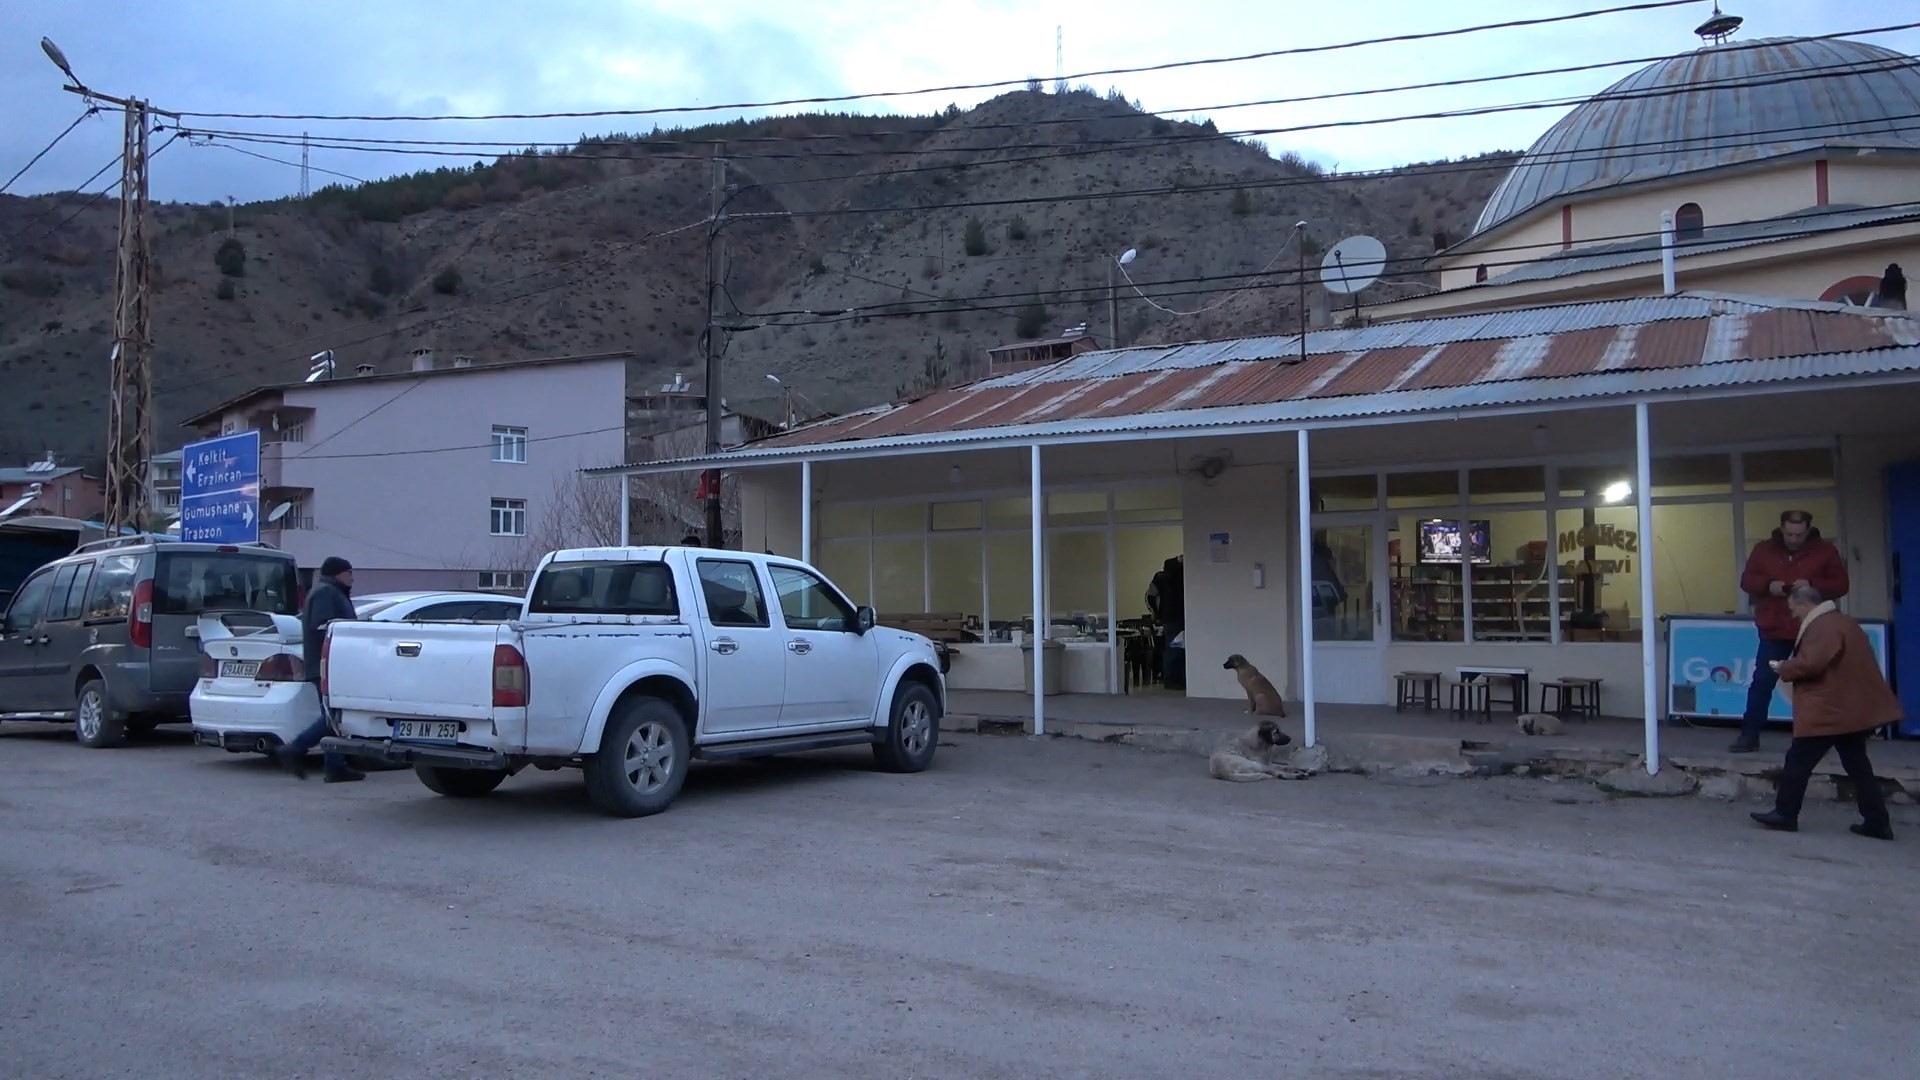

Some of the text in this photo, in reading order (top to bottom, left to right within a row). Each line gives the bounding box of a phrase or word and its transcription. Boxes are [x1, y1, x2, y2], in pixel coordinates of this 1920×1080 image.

[198, 448, 227, 466] Kelkit
[197, 470, 242, 488] Erzincan
[184, 526, 222, 541] Trabzon
[400, 722, 456, 738] 29 AN 253
